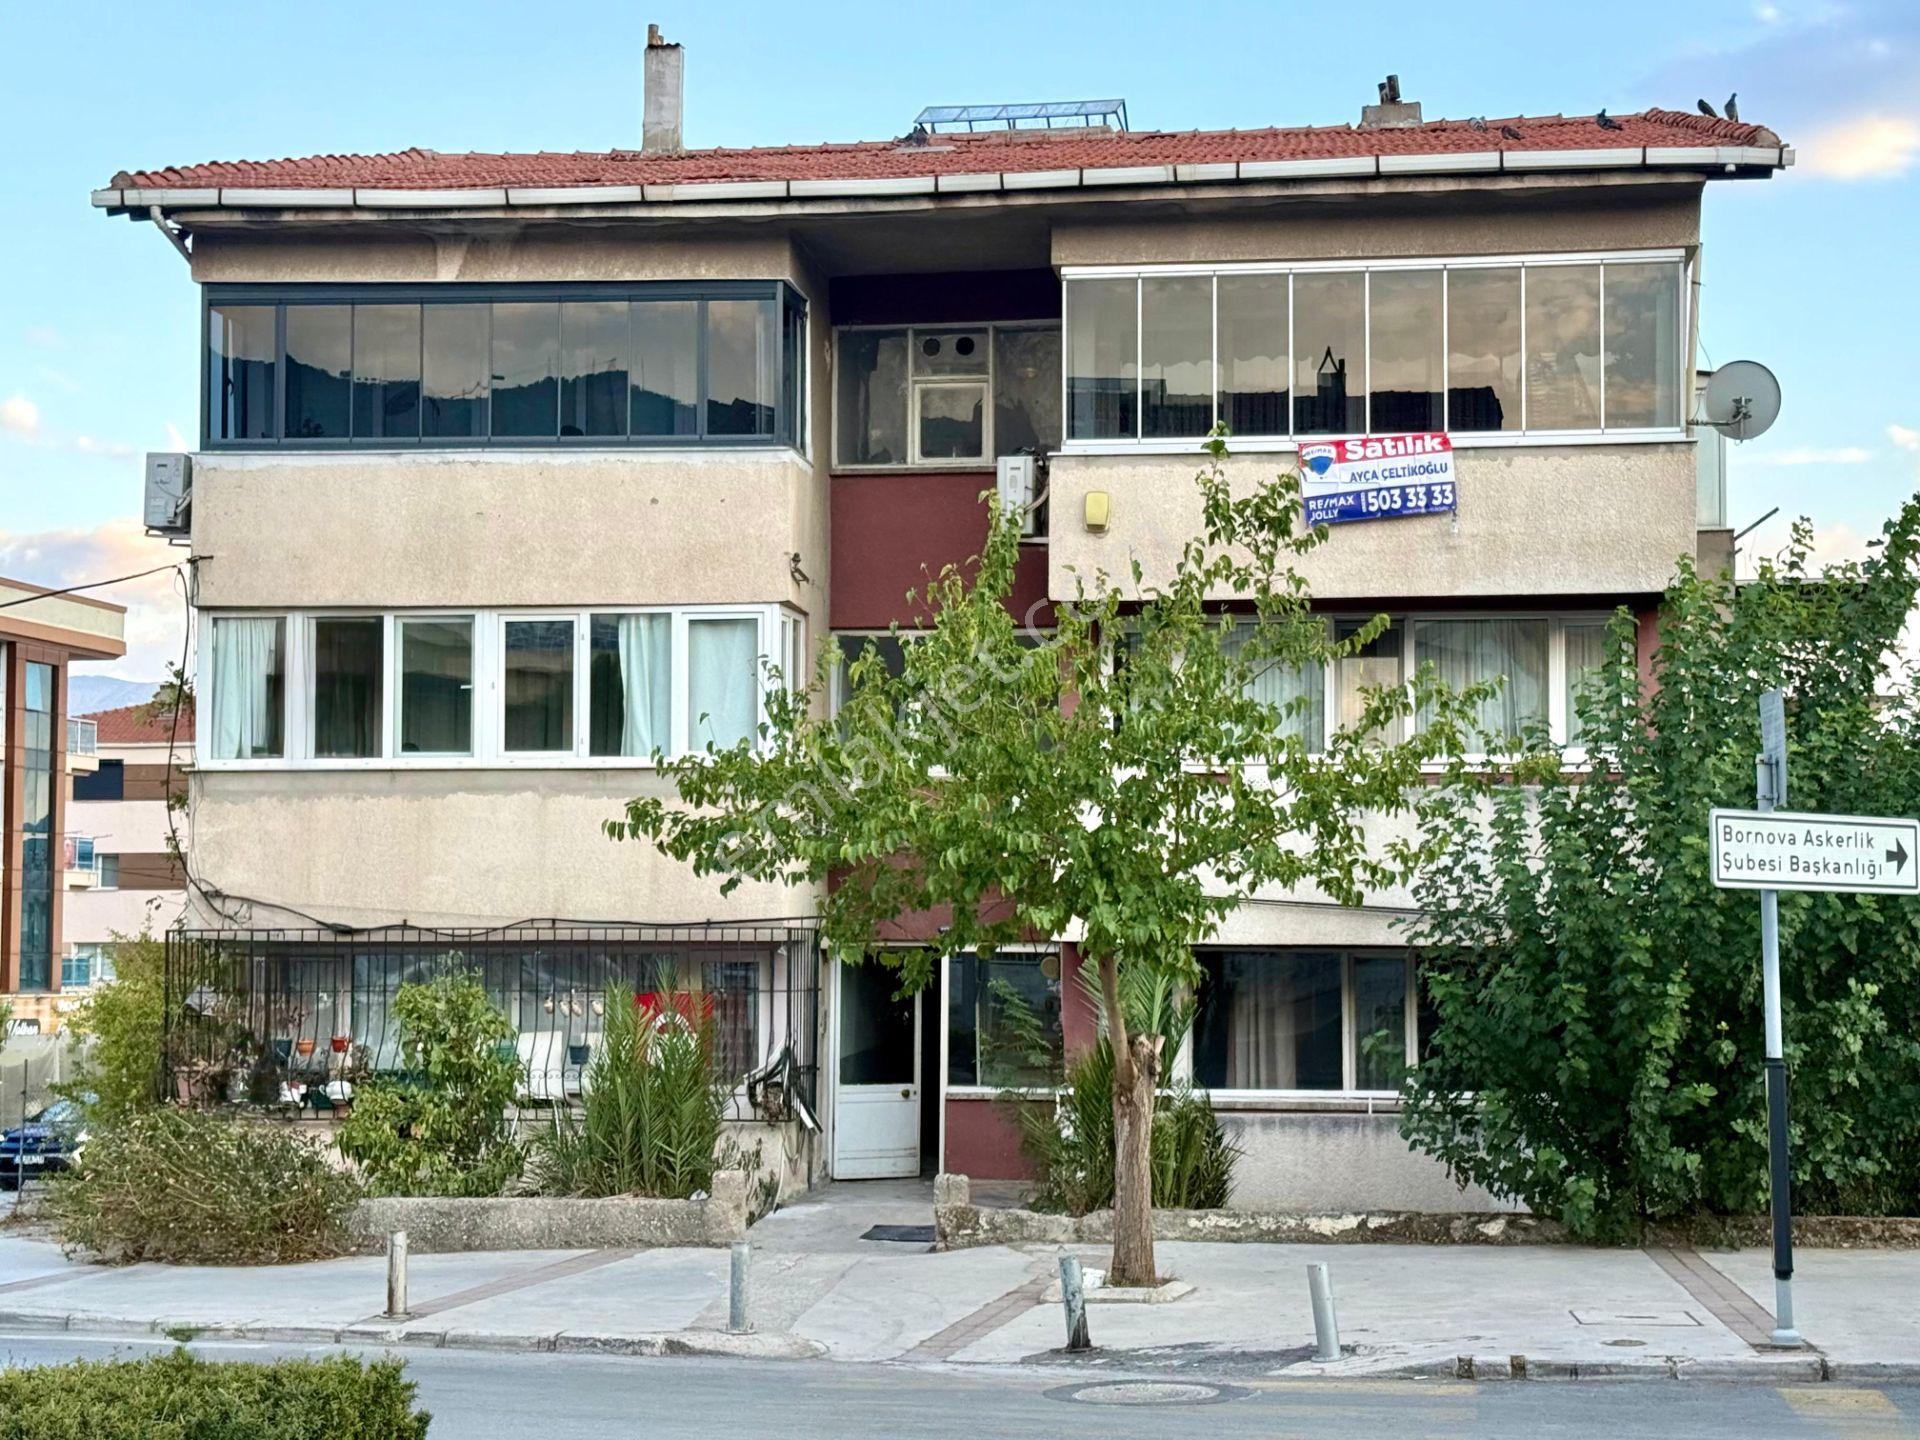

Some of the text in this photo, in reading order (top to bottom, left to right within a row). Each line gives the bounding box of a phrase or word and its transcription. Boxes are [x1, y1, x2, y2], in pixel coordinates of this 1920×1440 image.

[1344, 435, 1444, 460] Satılık
[1350, 462, 1448, 483] AYÇA ÇELTİKOĞLU
[1309, 495, 1355, 510] RE/MAX
[1367, 488, 1402, 512] 503
[1405, 486, 1427, 508] 33
[1431, 484, 1454, 506] 33
[1309, 509, 1339, 522] JOLLY
[1723, 825, 1875, 849] Bornova Askerlik
[1723, 851, 1882, 880] Şubesi Başkanlığı
